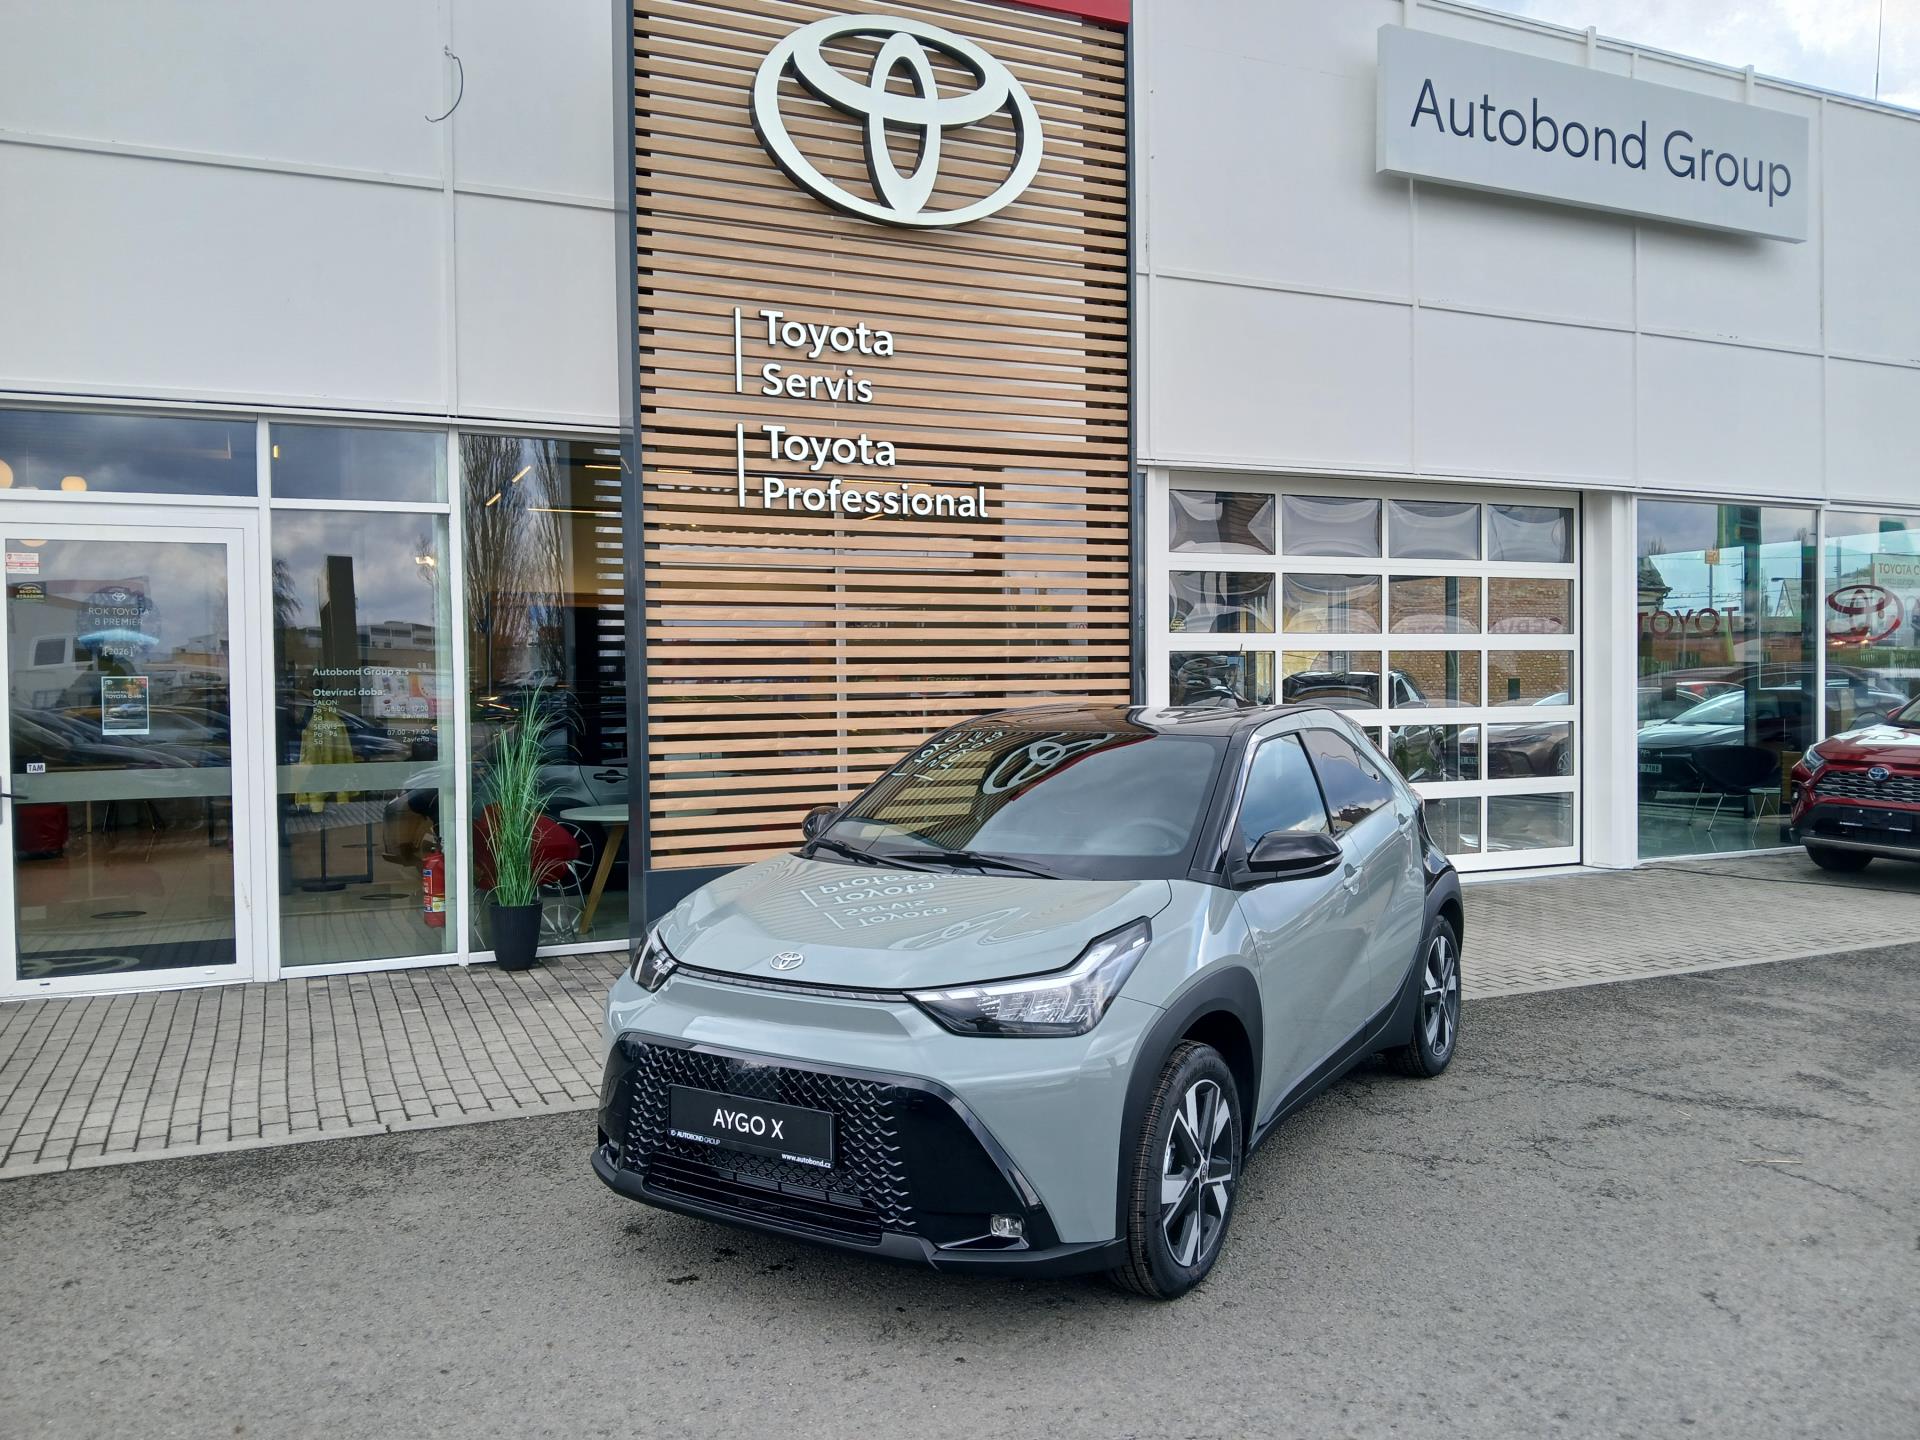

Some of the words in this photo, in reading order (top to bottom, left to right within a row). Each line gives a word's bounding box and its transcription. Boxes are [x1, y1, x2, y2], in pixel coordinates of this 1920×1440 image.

[1411, 78, 1647, 170] Autobond
[1664, 130, 1791, 207] Group
[760, 309, 894, 359] Toyota
[762, 363, 873, 403] Servis
[763, 424, 896, 471] Toyota
[763, 477, 989, 518] Professional
[1878, 562, 1912, 576] TOYOTA
[88, 607, 109, 616] ROK
[112, 607, 150, 616] TOYOTA
[313, 668, 361, 676] Autobond
[363, 667, 394, 678] Group
[313, 688, 356, 696] Otevírací
[27, 764, 44, 772] TAM
[713, 1108, 766, 1136] AYGO
[771, 1118, 784, 1140] X
[676, 1131, 704, 1142] AUTOBOND
[704, 1136, 721, 1145] GROUP
[781, 1152, 832, 1169] www.autobond.cz
